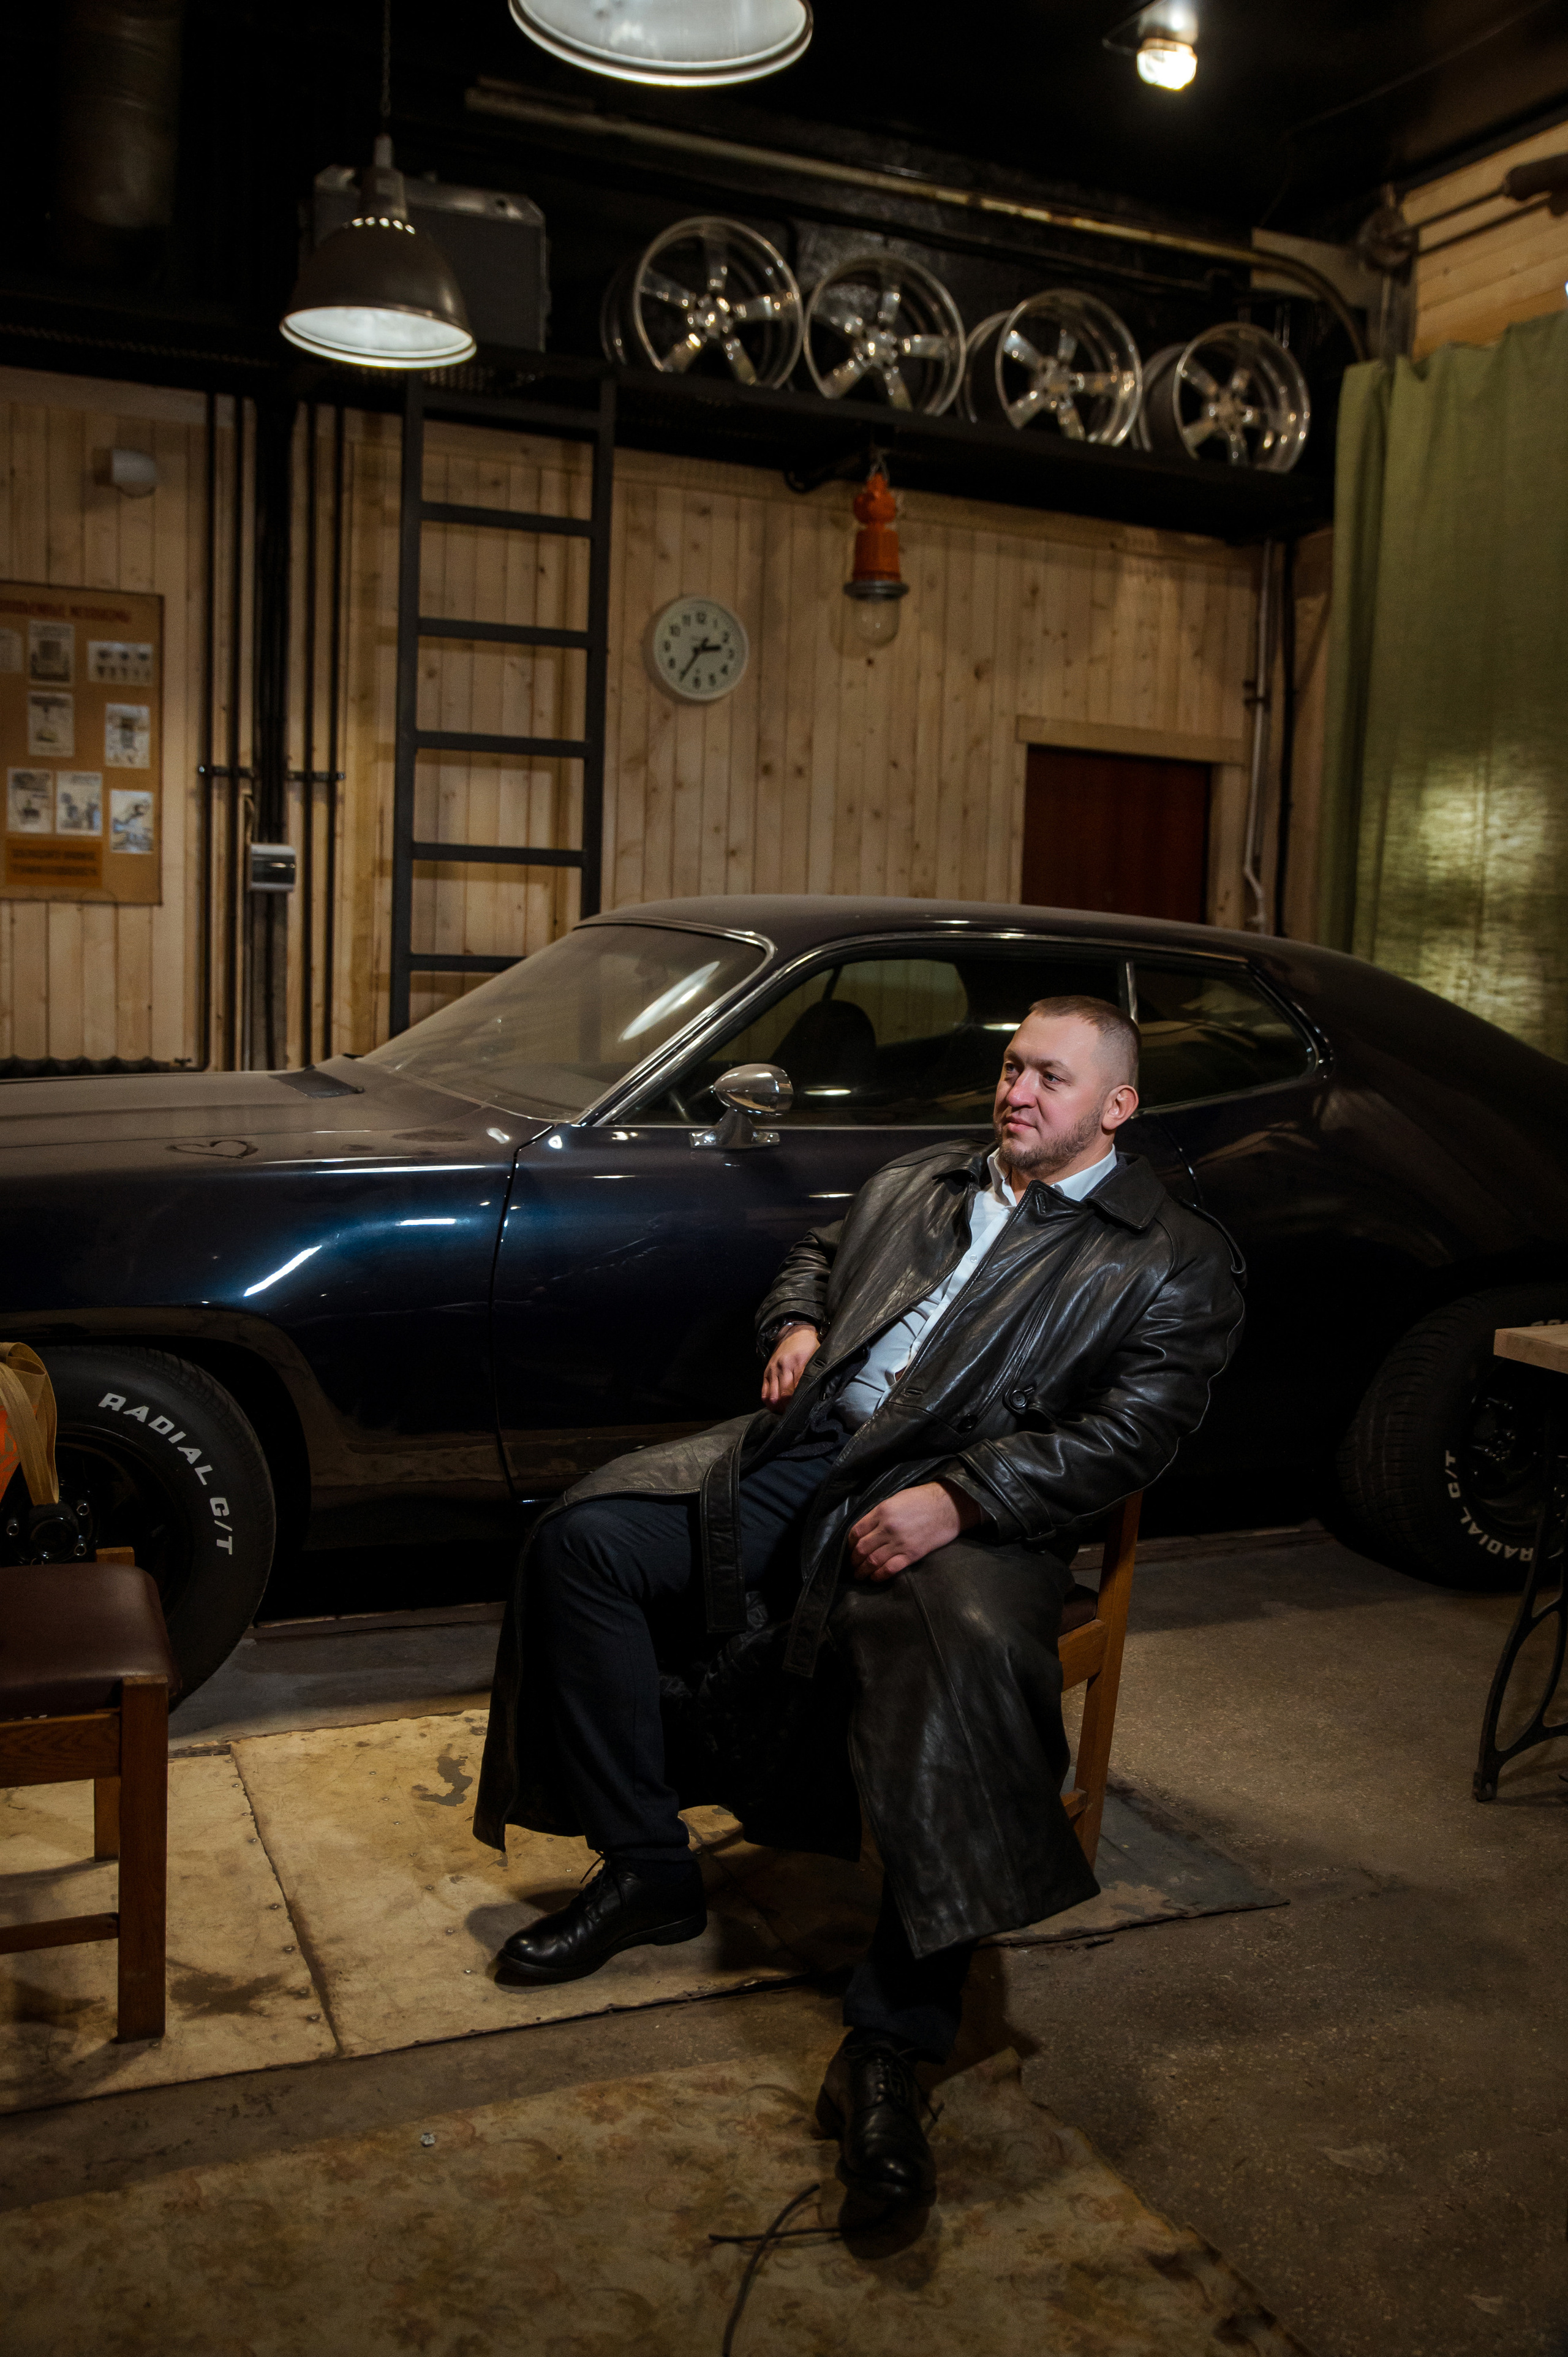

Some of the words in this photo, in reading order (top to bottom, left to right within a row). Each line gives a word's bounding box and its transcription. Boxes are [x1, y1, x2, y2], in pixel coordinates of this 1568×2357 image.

[99, 1393, 213, 1485] RADIAL
[209, 1497, 233, 1555] G/T
[1444, 1450, 1461, 1499] G/T
[1460, 1507, 1534, 1562] RADIAL
